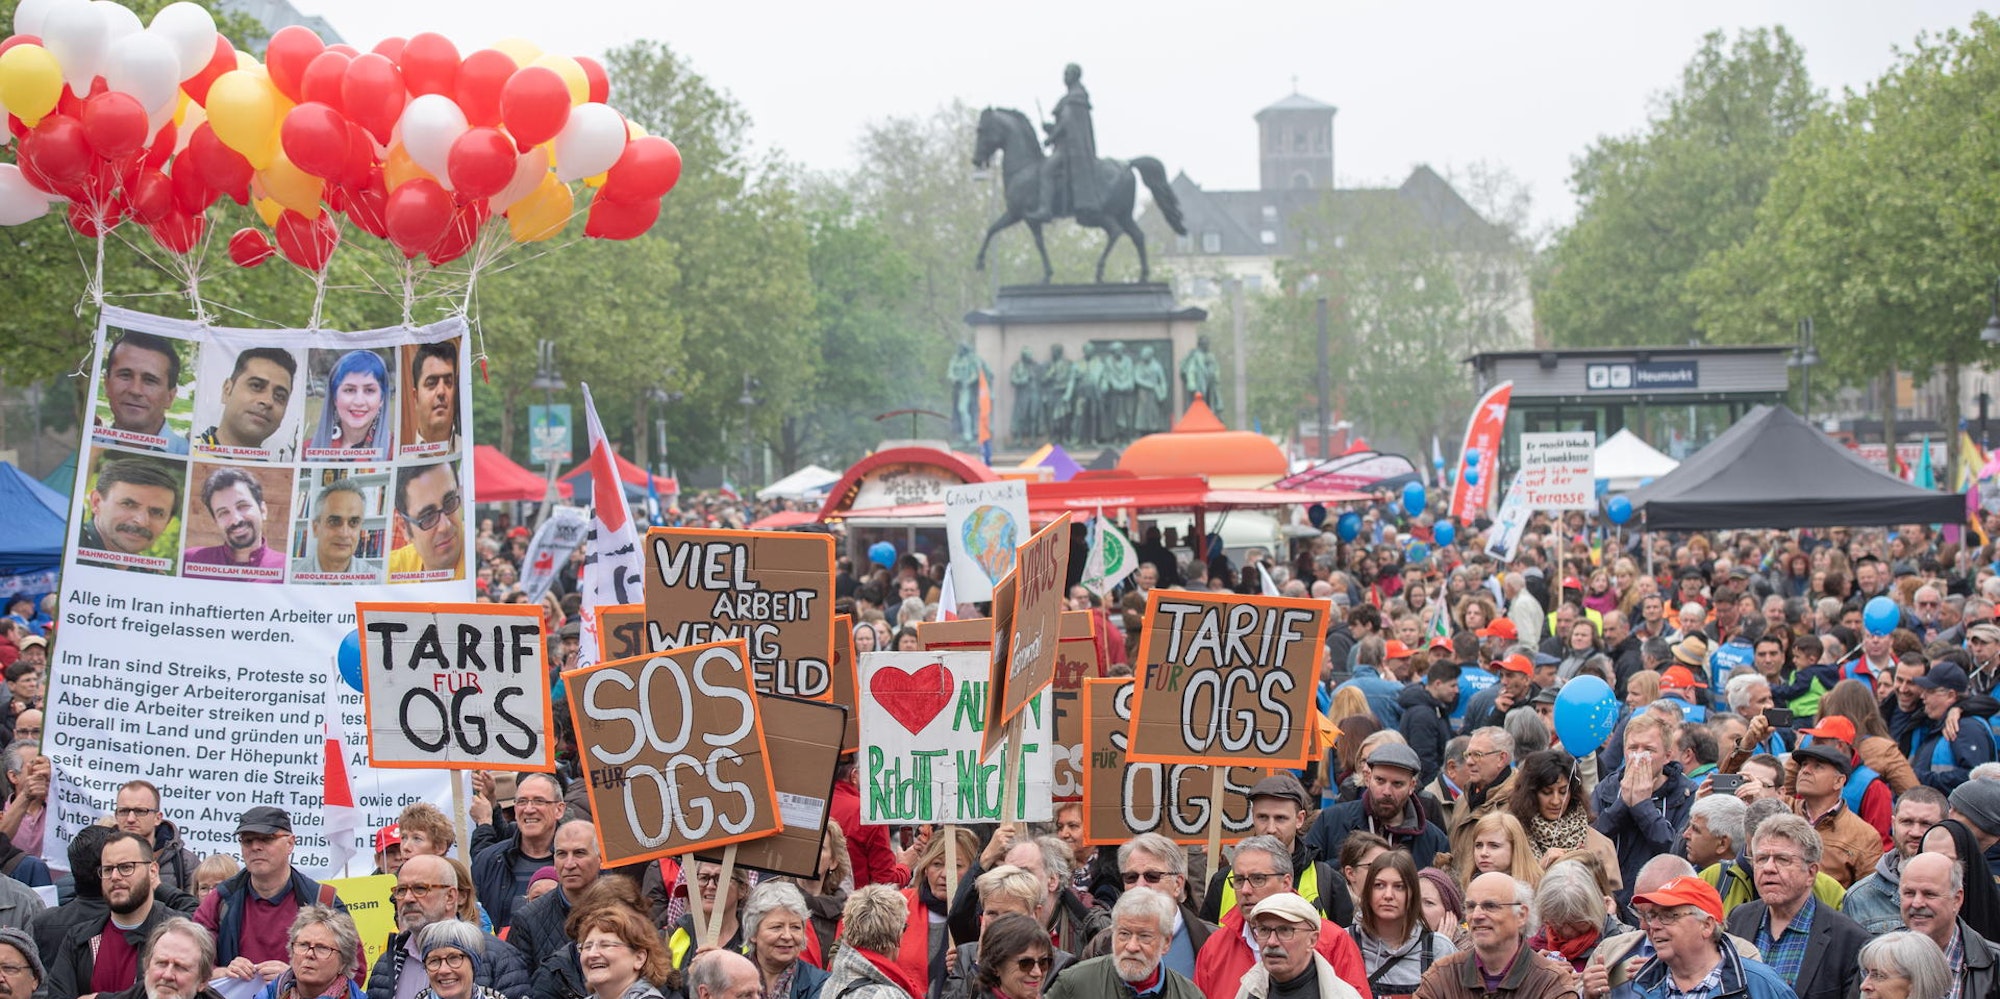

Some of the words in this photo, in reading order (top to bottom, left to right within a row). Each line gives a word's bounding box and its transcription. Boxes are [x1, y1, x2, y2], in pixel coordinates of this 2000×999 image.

[1637, 369, 1692, 382] Heumarkt
[1527, 490, 1584, 504] Terrasse
[78, 548, 121, 561] MAHMOOD
[123, 556, 166, 567] BEHESHTI
[187, 564, 240, 575] ROUHOLLAH
[653, 537, 760, 592] VIEL
[1021, 533, 1059, 611] VIRUS
[68, 590, 101, 606] Alle
[106, 594, 126, 610] im
[132, 597, 164, 614] Iran
[170, 601, 265, 622] inhaftierten
[269, 608, 333, 624] Arbeiter
[337, 613, 356, 624] un
[710, 589, 818, 623] ARBEIT
[66, 612, 117, 629] sofort
[121, 617, 225, 640] freigelassen
[231, 628, 294, 643] werden.
[647, 620, 781, 662] WENIG
[1158, 602, 1315, 668] TARIF
[367, 621, 540, 674] TARIF
[62, 650, 82, 666] Im
[88, 653, 120, 670] Iran
[125, 659, 162, 674] sind
[168, 662, 231, 682] Streiks,
[237, 667, 304, 684] Proteste
[433, 670, 482, 694] FÜR
[752, 657, 832, 698] ELD
[1144, 661, 1184, 692] FÜR
[60, 674, 179, 698] unabhängiger
[58, 691, 99, 708] Aber
[104, 697, 129, 712] die
[134, 700, 204, 719] Arbeiter
[208, 707, 274, 722] streiken
[280, 710, 310, 723] und
[400, 686, 537, 759] OGS
[582, 646, 755, 765] SOS
[1181, 667, 1295, 754] OGS
[57, 711, 114, 731] überall
[120, 719, 140, 734] im
[146, 721, 188, 738] Land
[195, 726, 226, 741] und
[231, 728, 299, 744] gründen
[54, 731, 190, 758] Organisationen.
[196, 745, 226, 761] Der
[231, 748, 318, 767] Höhepunkt
[1092, 747, 1117, 769] FÜR
[52, 753, 83, 768] seit
[88, 758, 140, 775] einem
[145, 762, 184, 778] Jahr
[189, 767, 238, 782] waren
[244, 769, 269, 783] die
[591, 766, 626, 790] FÜR
[868, 745, 948, 821] REICHT
[58, 788, 118, 811] Stahlarb
[164, 806, 195, 820] von
[200, 807, 243, 822] Ahva
[368, 813, 401, 828] Lan
[216, 791, 246, 803] von
[252, 790, 285, 805] Haft
[290, 791, 325, 809] Tapp
[359, 793, 393, 807] owie
[623, 746, 756, 848] OGS
[57, 806, 100, 826] Unter
[179, 826, 242, 844] Protest
[290, 852, 329, 867] Lebe
[346, 900, 379, 911] nsam
